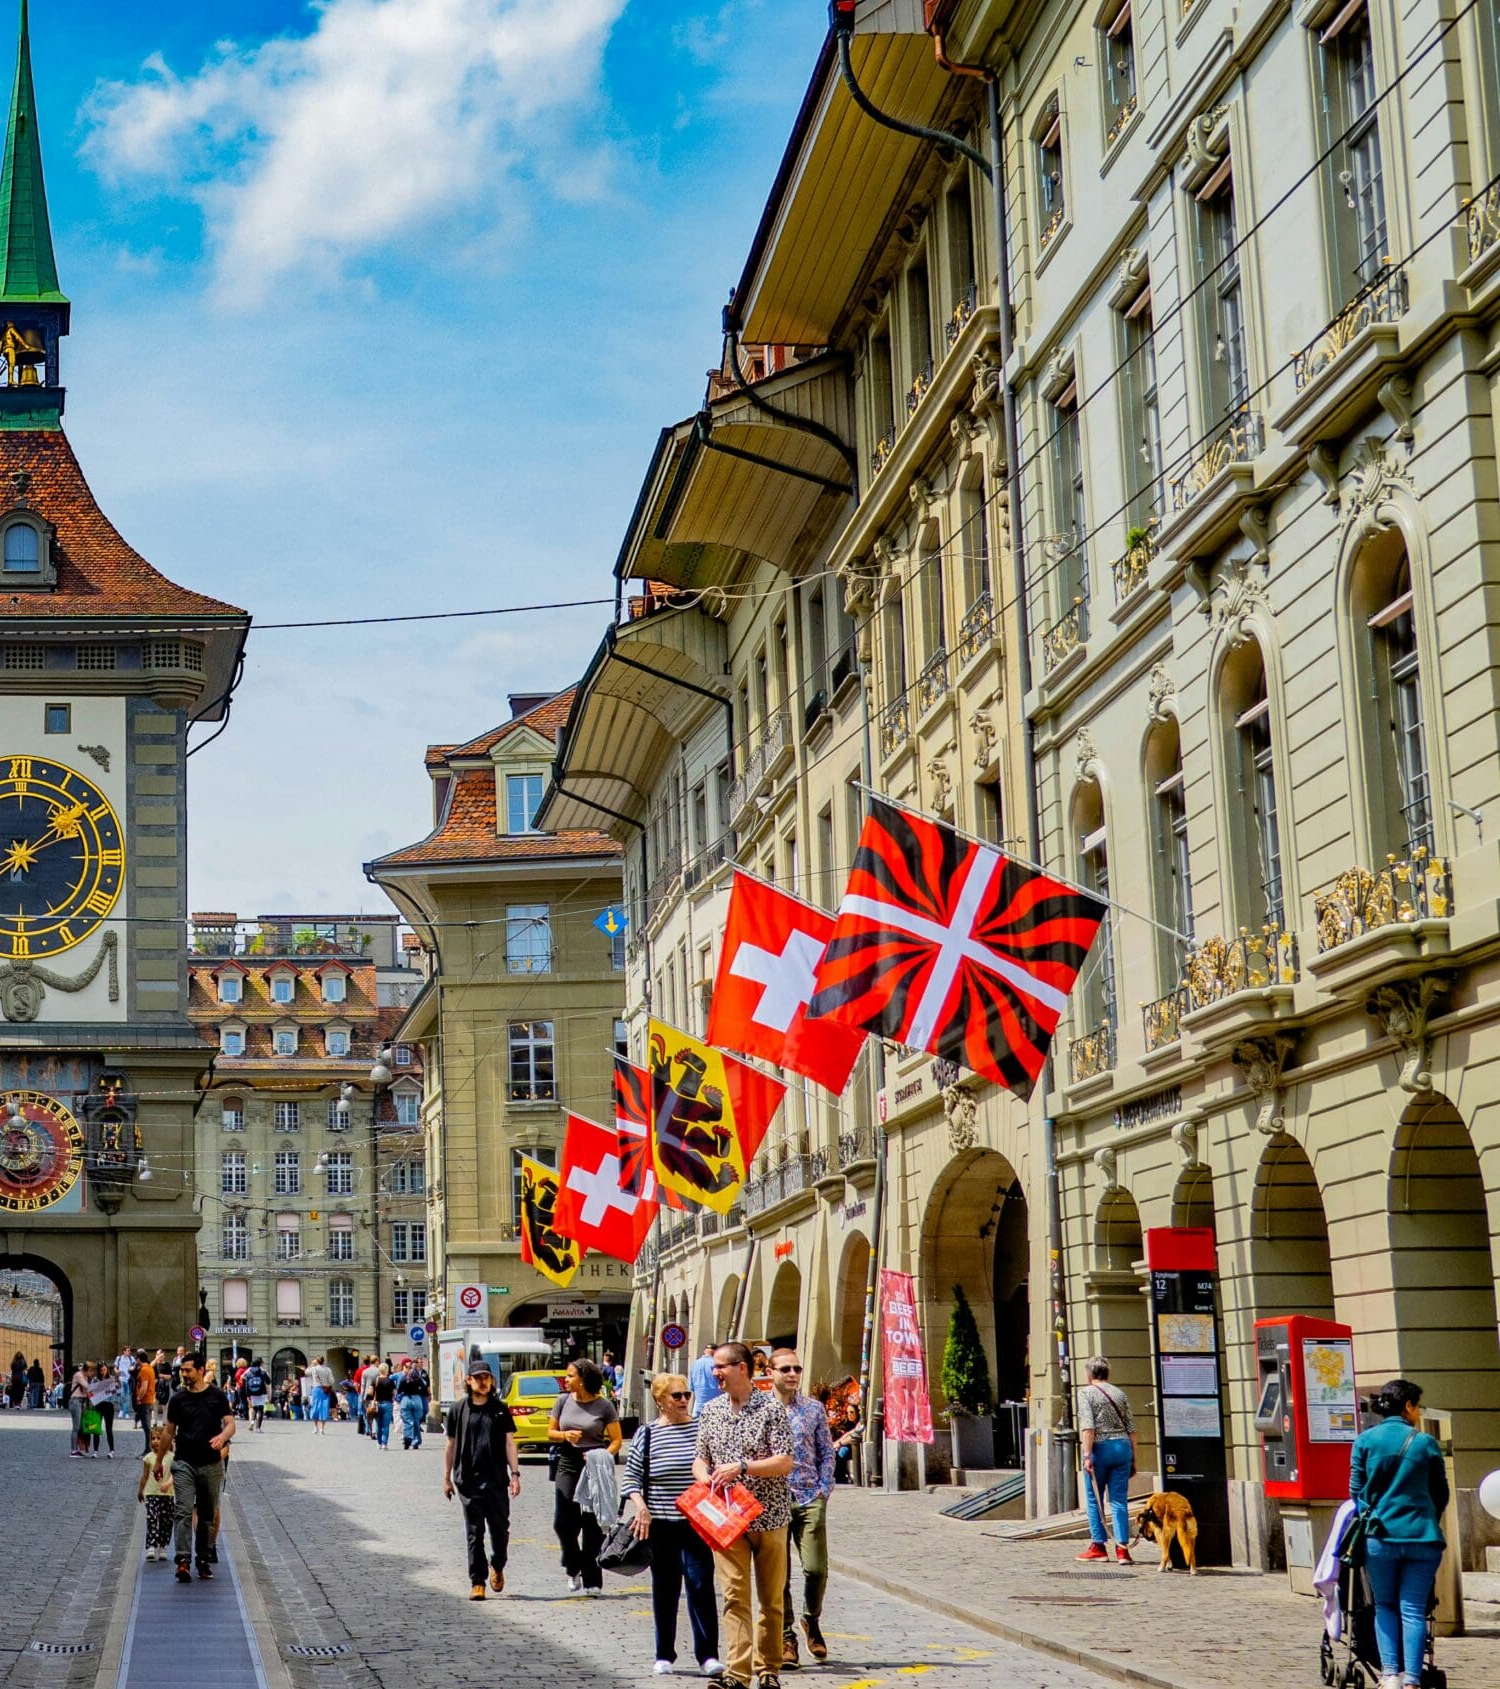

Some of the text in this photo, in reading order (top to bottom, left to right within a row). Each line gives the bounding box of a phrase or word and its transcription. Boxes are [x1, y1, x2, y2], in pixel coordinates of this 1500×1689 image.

[9, 760, 32, 778] XII
[60, 773, 72, 789] I
[90, 804, 109, 821] II
[101, 849, 121, 865] III
[87, 890, 112, 915] IIII
[59, 926, 75, 944] V
[12, 936, 29, 955] VI
[1156, 1280, 1166, 1289] 12
[889, 1302, 912, 1316] BEEF
[900, 1318, 910, 1330] IN
[892, 1361, 922, 1374] BEEF
